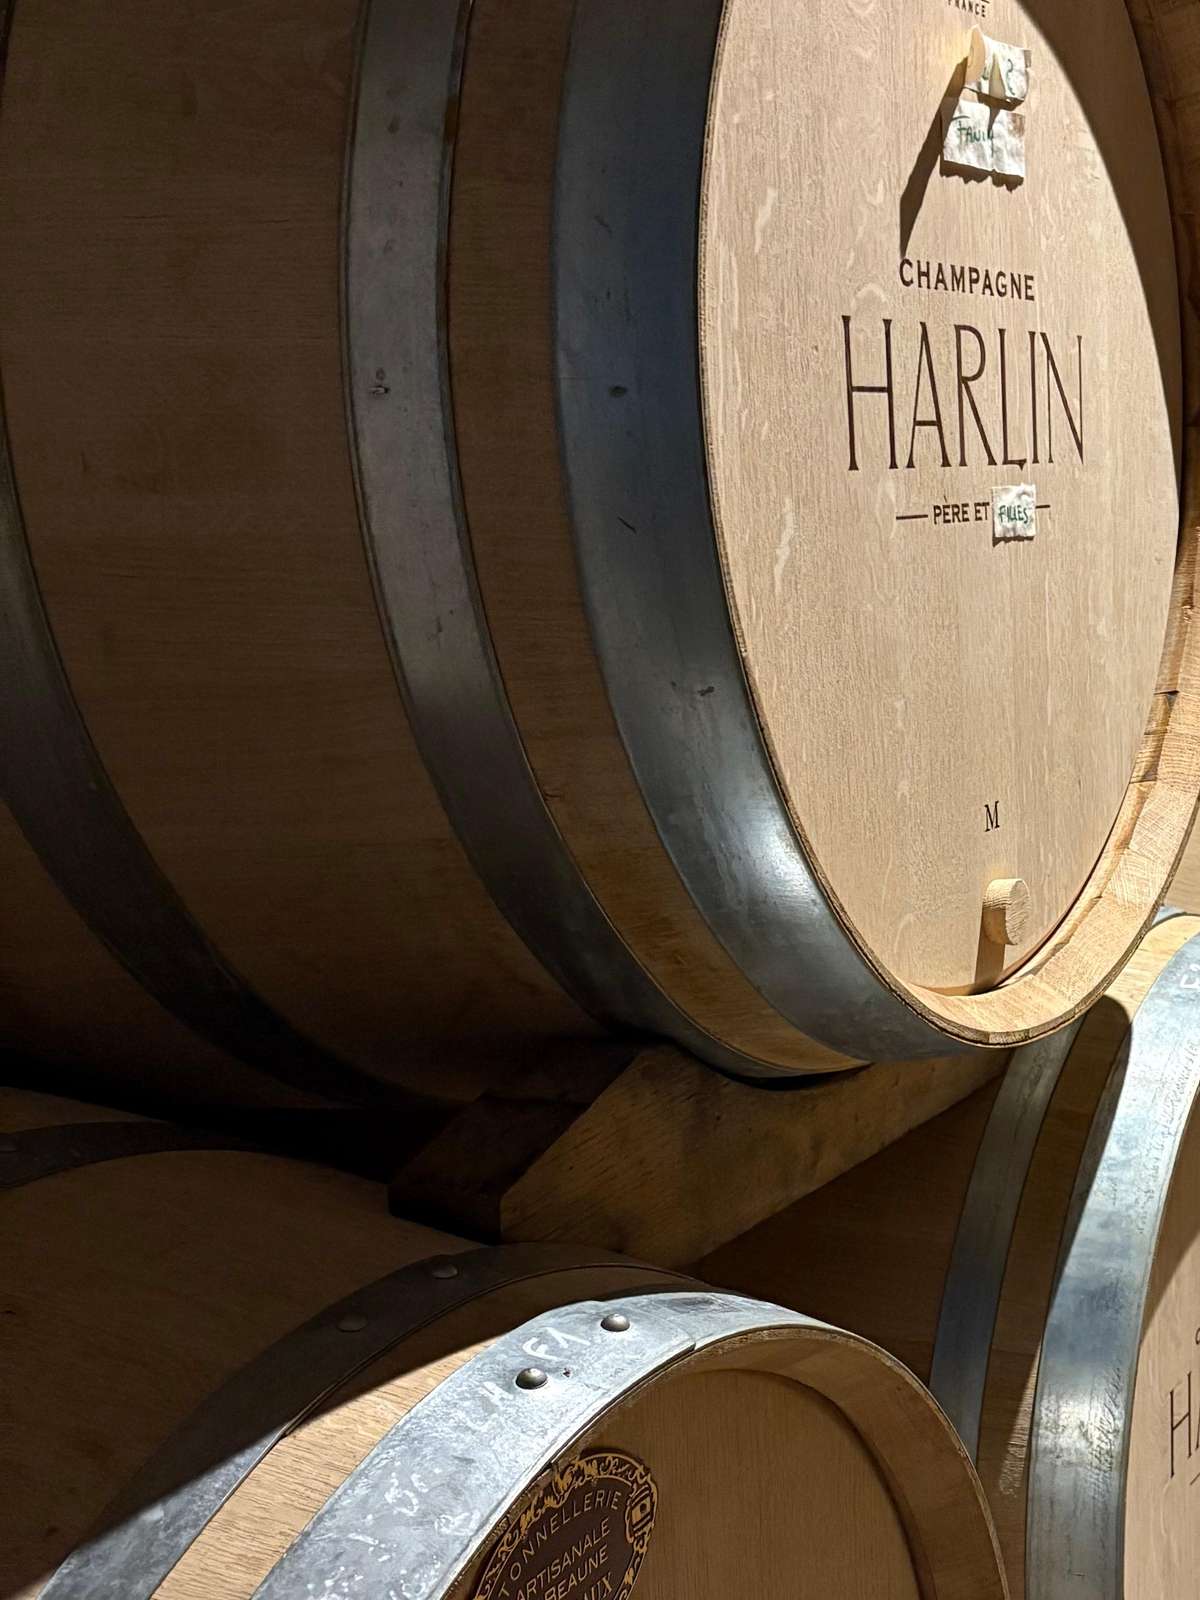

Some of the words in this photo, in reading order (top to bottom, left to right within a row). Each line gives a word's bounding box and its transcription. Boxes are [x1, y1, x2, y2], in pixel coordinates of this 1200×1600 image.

[900, 258, 1035, 301] CHAMPAGNE
[841, 315, 1085, 471] HARLIN
[933, 495, 970, 525] PÈRE
[974, 502, 990, 522] ET
[984, 800, 1000, 832] M
[499, 1490, 622, 1597] TONNELLERIE
[516, 1517, 611, 1600] ARTISANALE
[544, 1544, 609, 1600] BEAUNE
